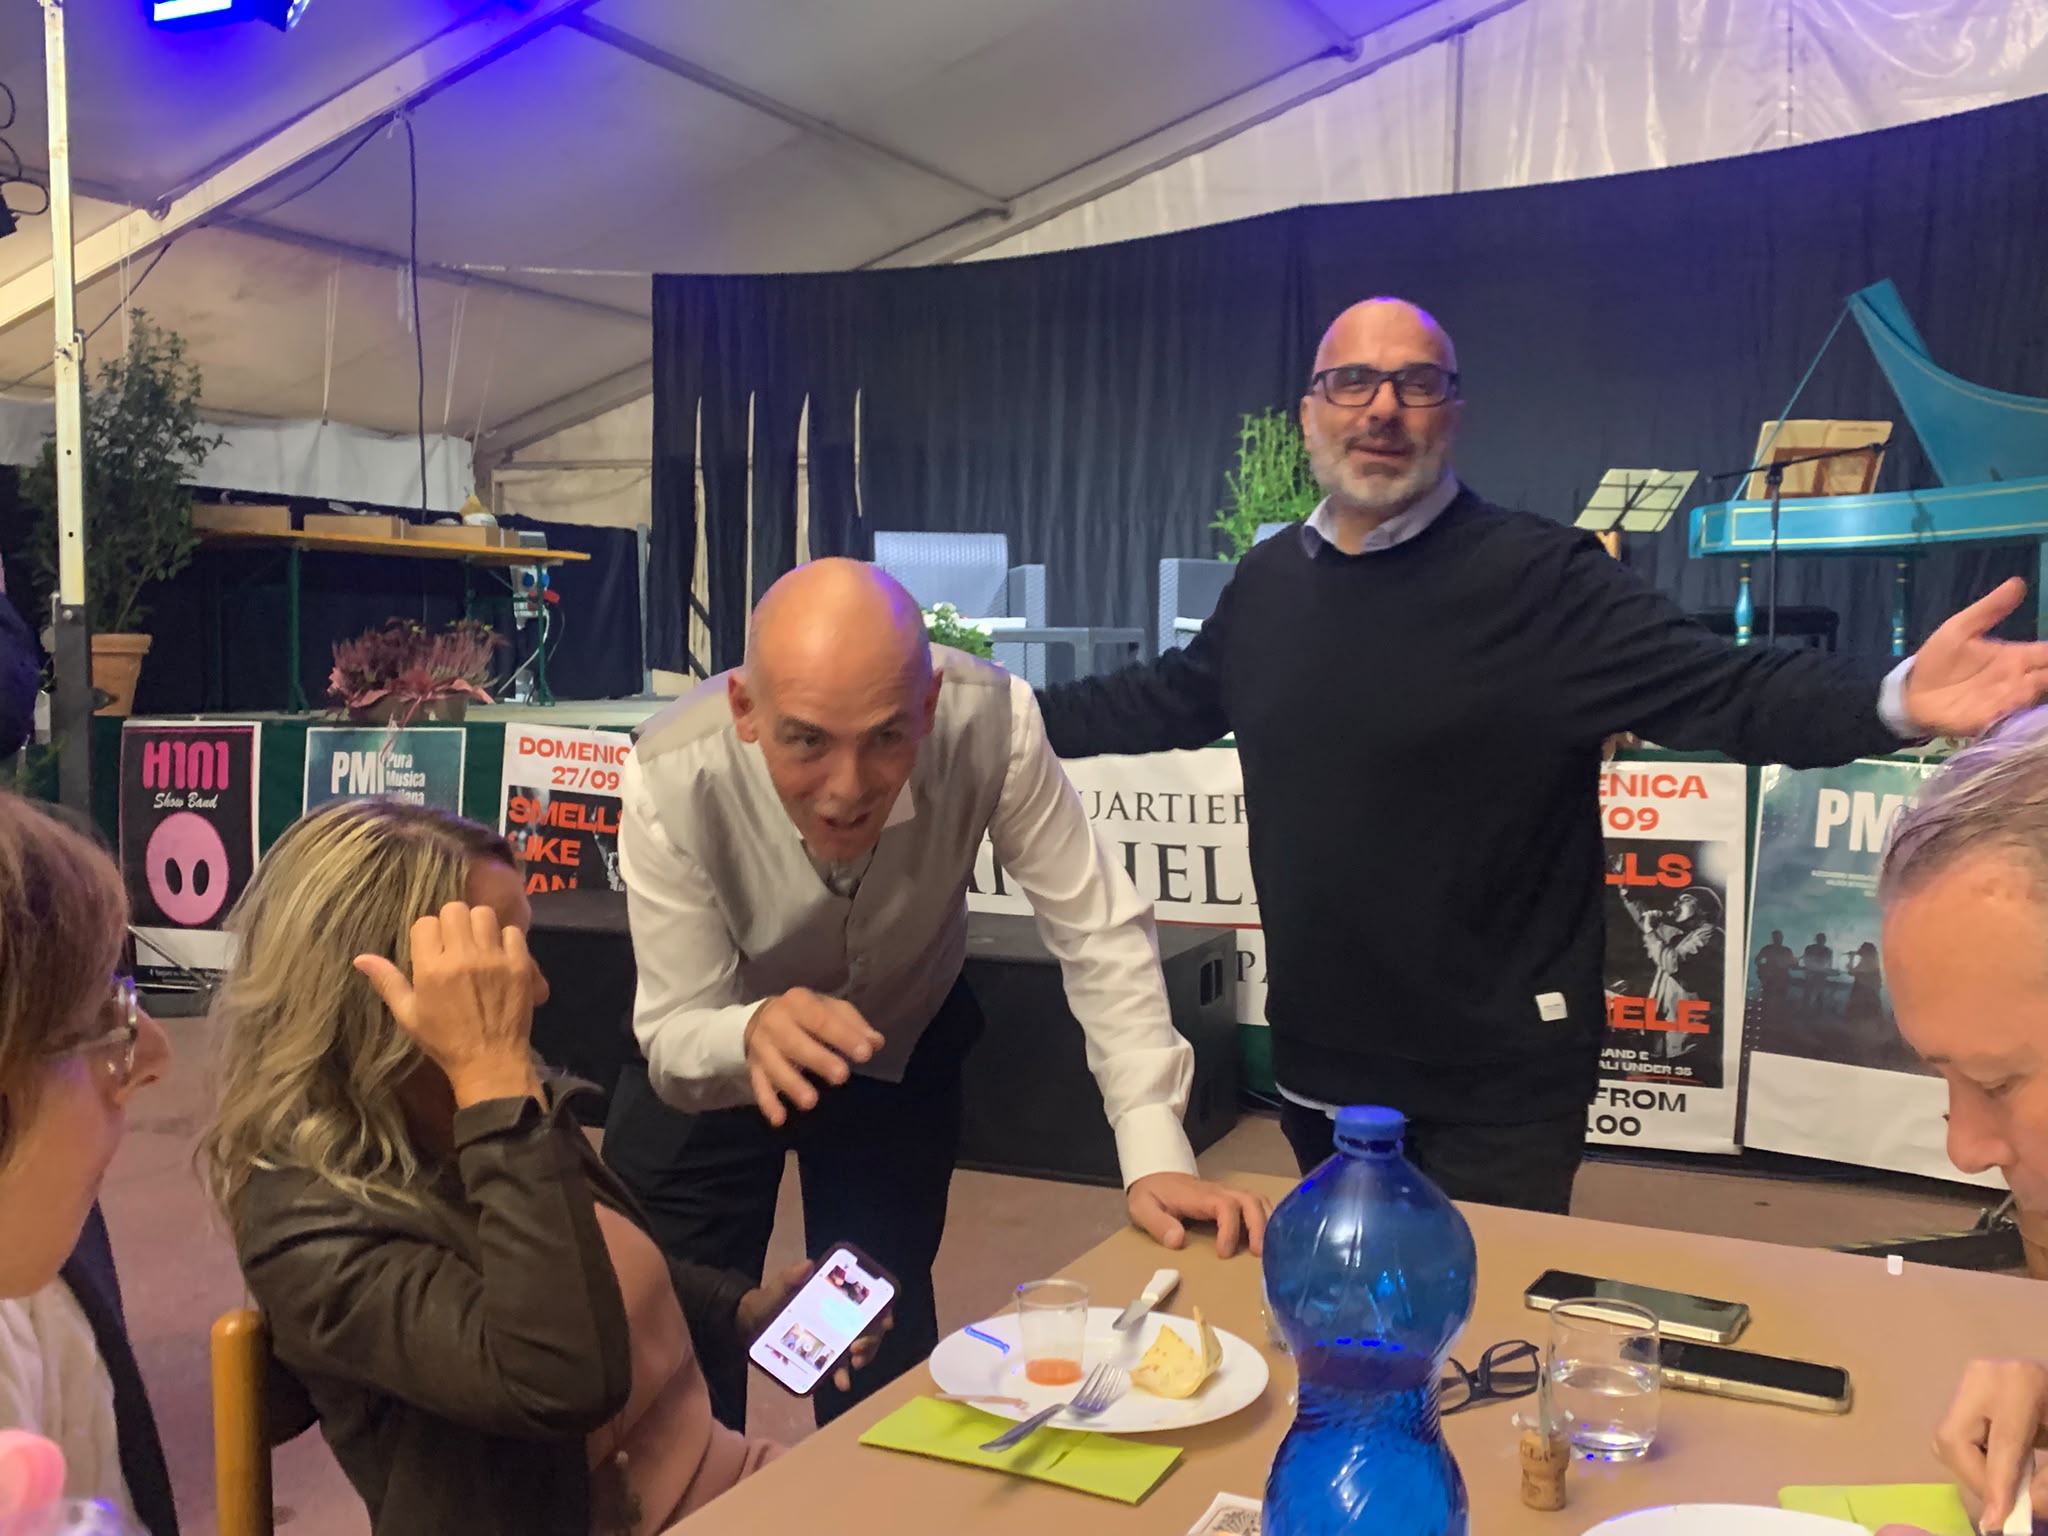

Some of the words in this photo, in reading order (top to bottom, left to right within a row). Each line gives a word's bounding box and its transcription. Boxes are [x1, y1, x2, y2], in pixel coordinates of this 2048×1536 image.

[331, 751, 385, 794] PMI
[386, 770, 426, 787] Musica
[551, 766, 620, 791] 27/09
[153, 791, 184, 808] Show
[187, 791, 219, 808] Band
[508, 796, 623, 834] SMELL
[1814, 788, 1919, 853] PM
[1622, 1061, 1672, 1075] UNDER
